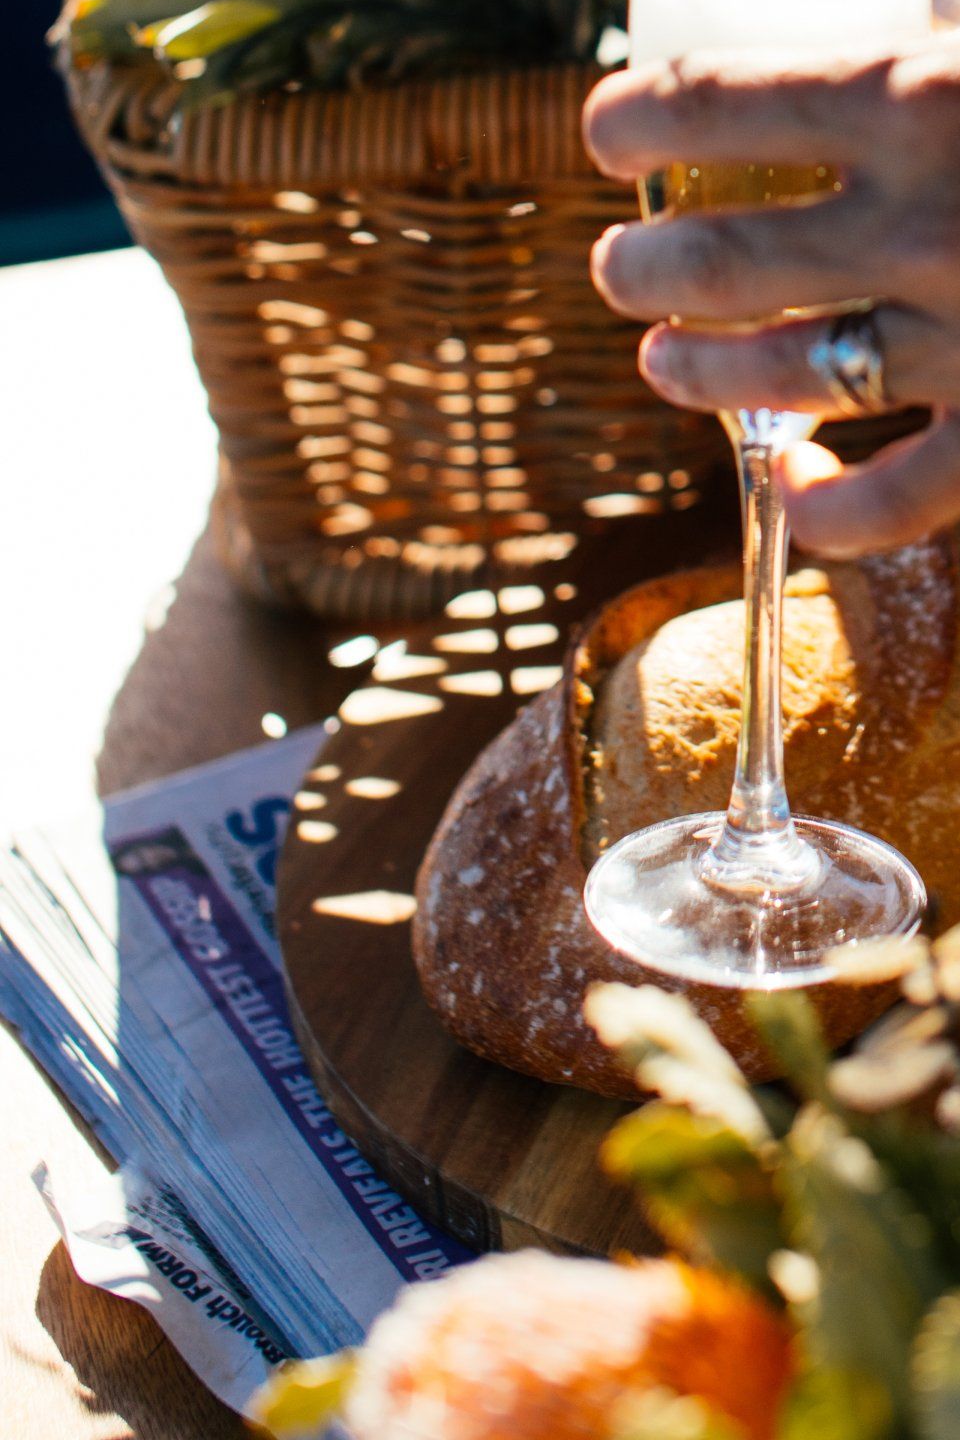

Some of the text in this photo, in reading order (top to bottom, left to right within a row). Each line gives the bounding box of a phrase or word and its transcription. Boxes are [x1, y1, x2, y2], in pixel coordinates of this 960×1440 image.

[206, 962, 305, 1070] HOTTEST
[280, 1074, 335, 1129] THE
[320, 1128, 432, 1249] REVEALS
